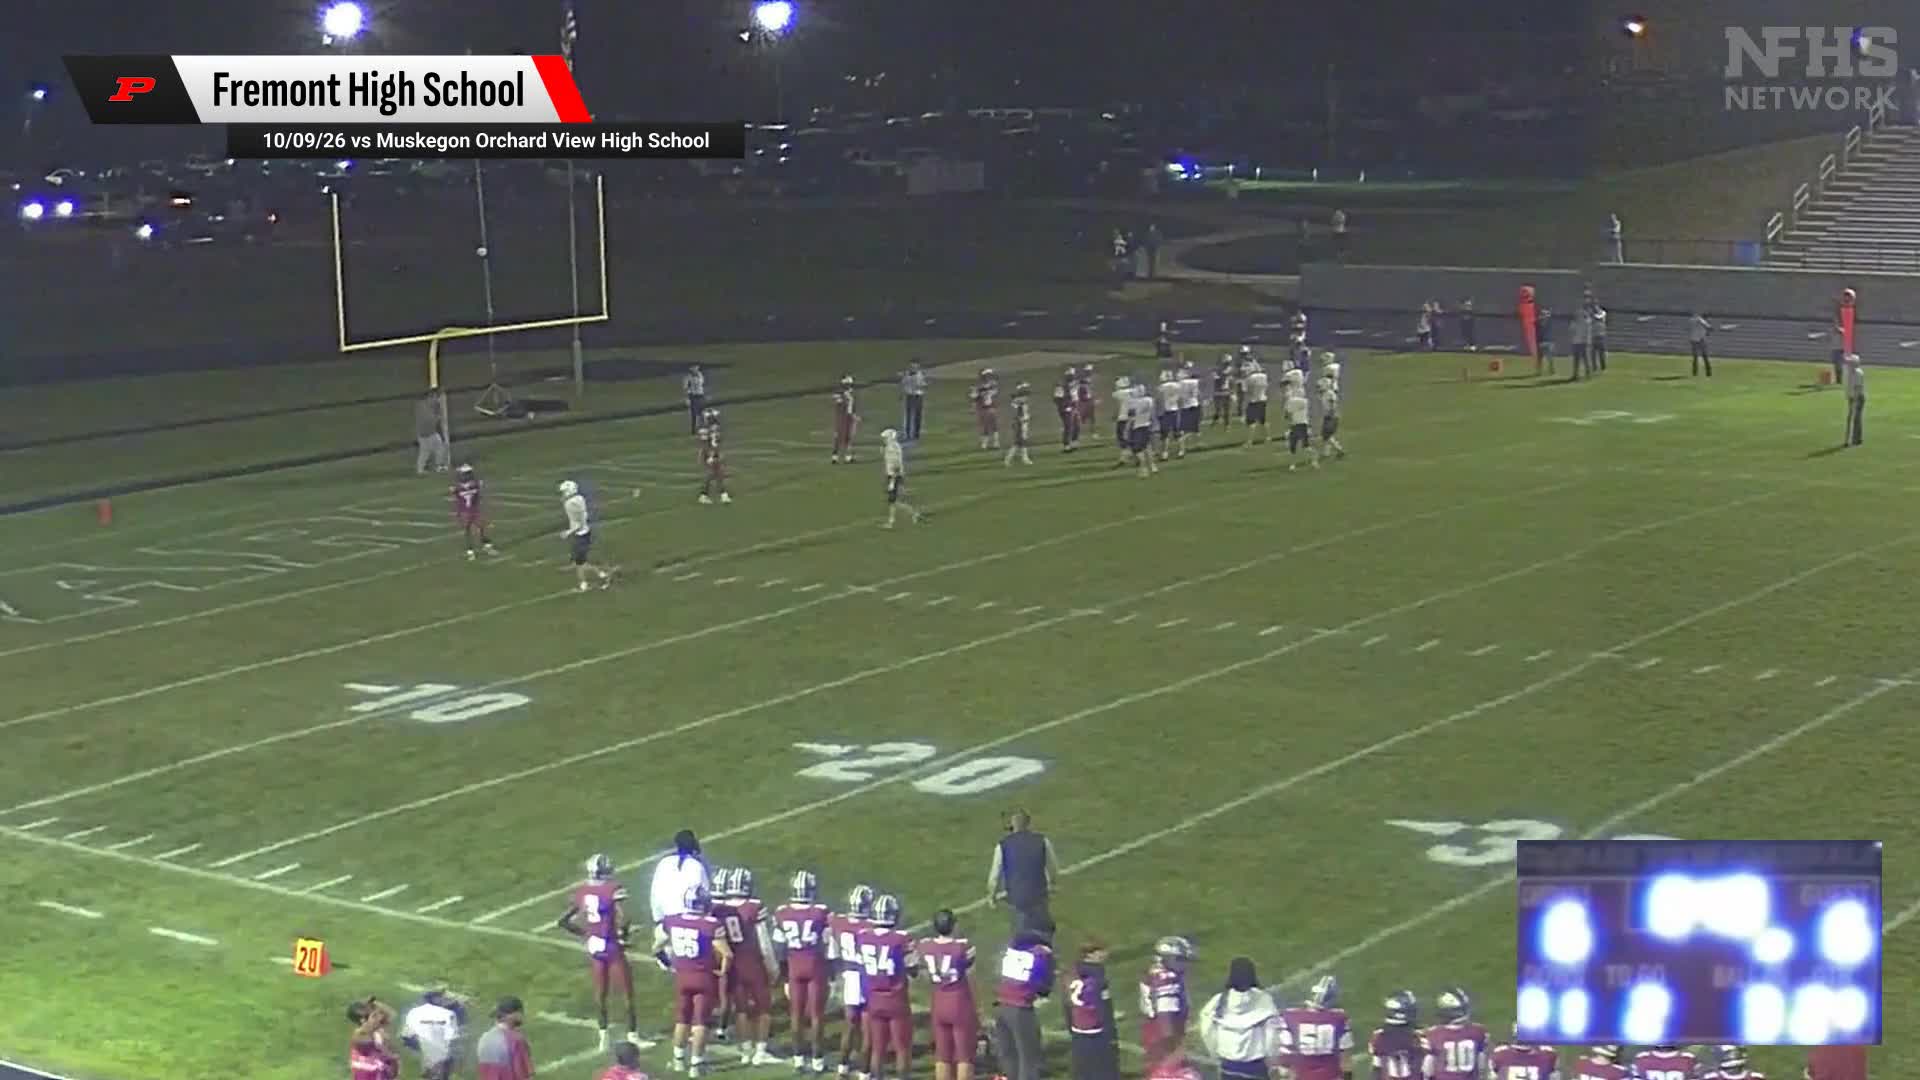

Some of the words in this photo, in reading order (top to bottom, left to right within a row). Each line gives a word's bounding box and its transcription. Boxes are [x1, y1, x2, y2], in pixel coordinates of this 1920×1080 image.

[783, 920, 818, 949] 24
[298, 946, 318, 972] 20
[862, 944, 895, 976] 54
[1443, 1039, 1475, 1072] 10
